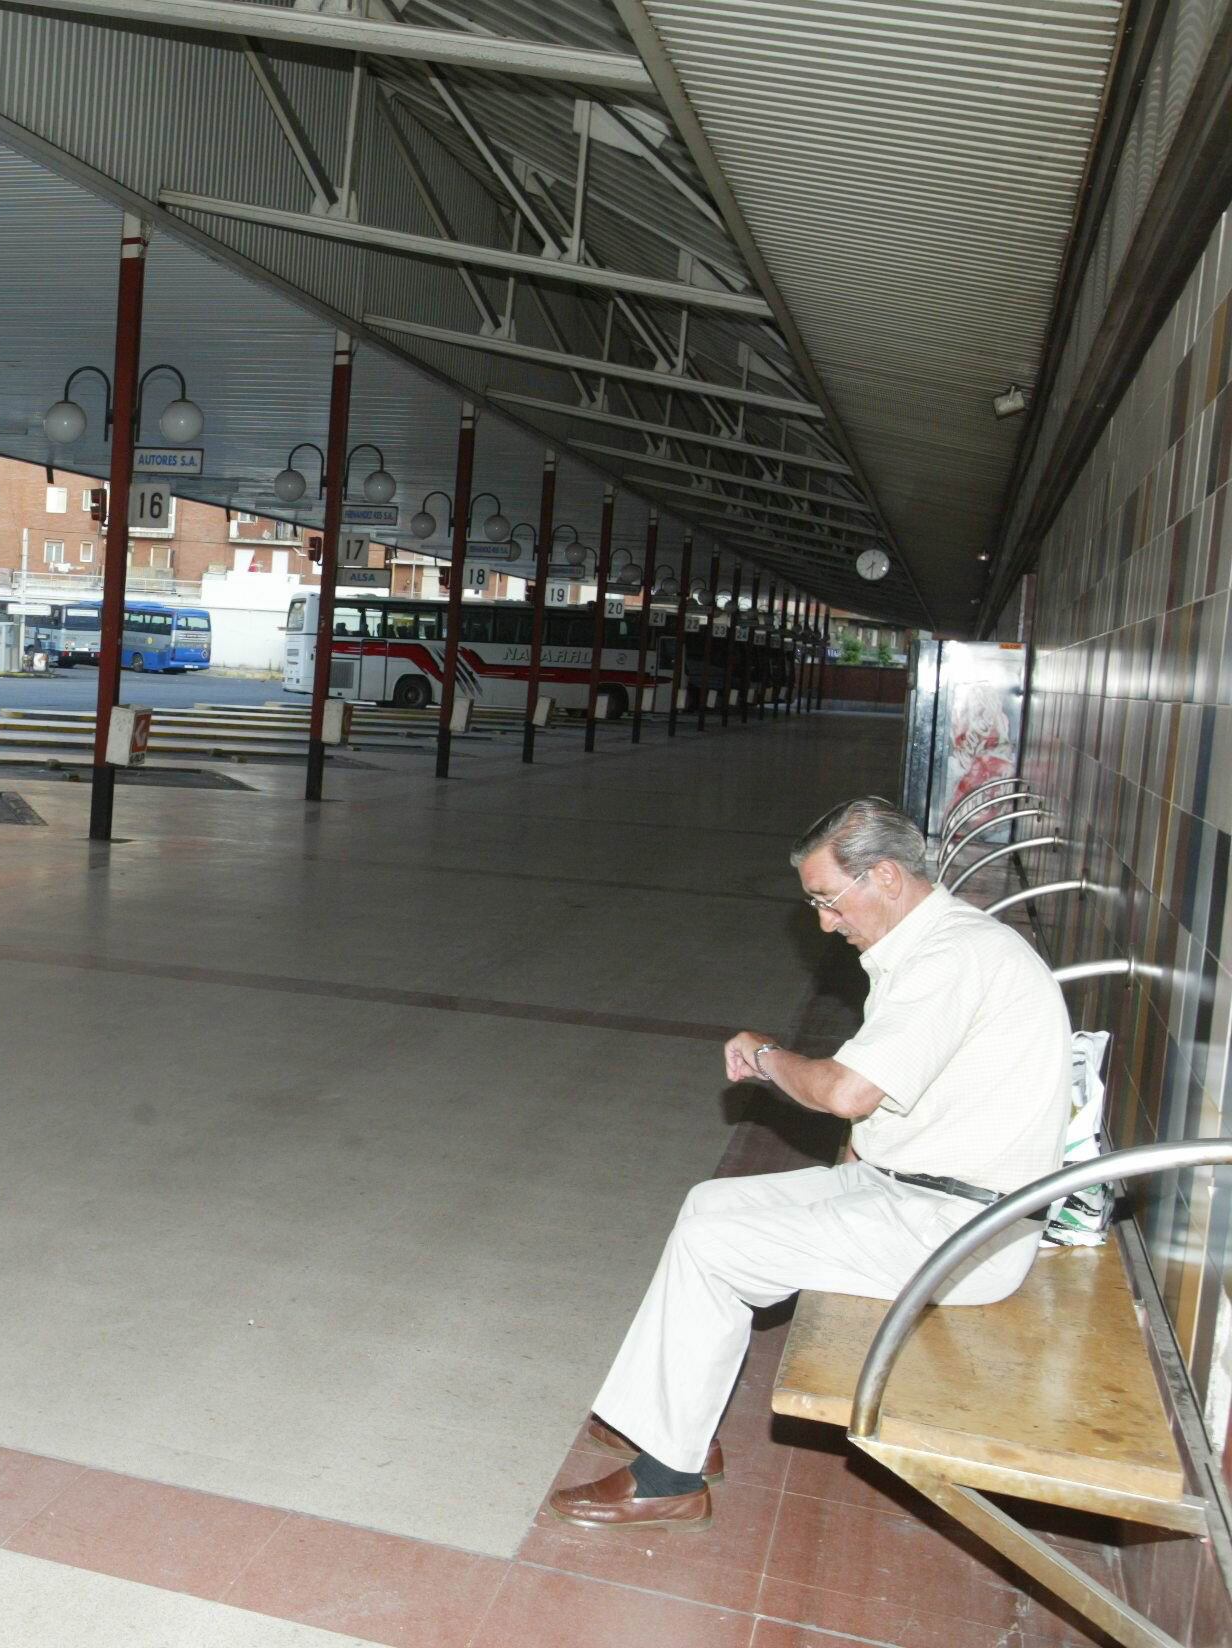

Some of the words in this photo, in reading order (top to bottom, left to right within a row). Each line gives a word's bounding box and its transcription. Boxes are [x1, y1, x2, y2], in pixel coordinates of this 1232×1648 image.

[137, 453, 177, 466] AUTORES
[180, 455, 198, 467] S.A.
[139, 492, 163, 519] 16
[346, 540, 364, 560] 17
[350, 573, 376, 582] ALSA
[469, 568, 485, 585] 18
[550, 588, 565, 602] 19
[608, 602, 623, 615] 20
[653, 612, 664, 623] 21
[688, 620, 698, 630] 22
[714, 626, 726, 635] 23
